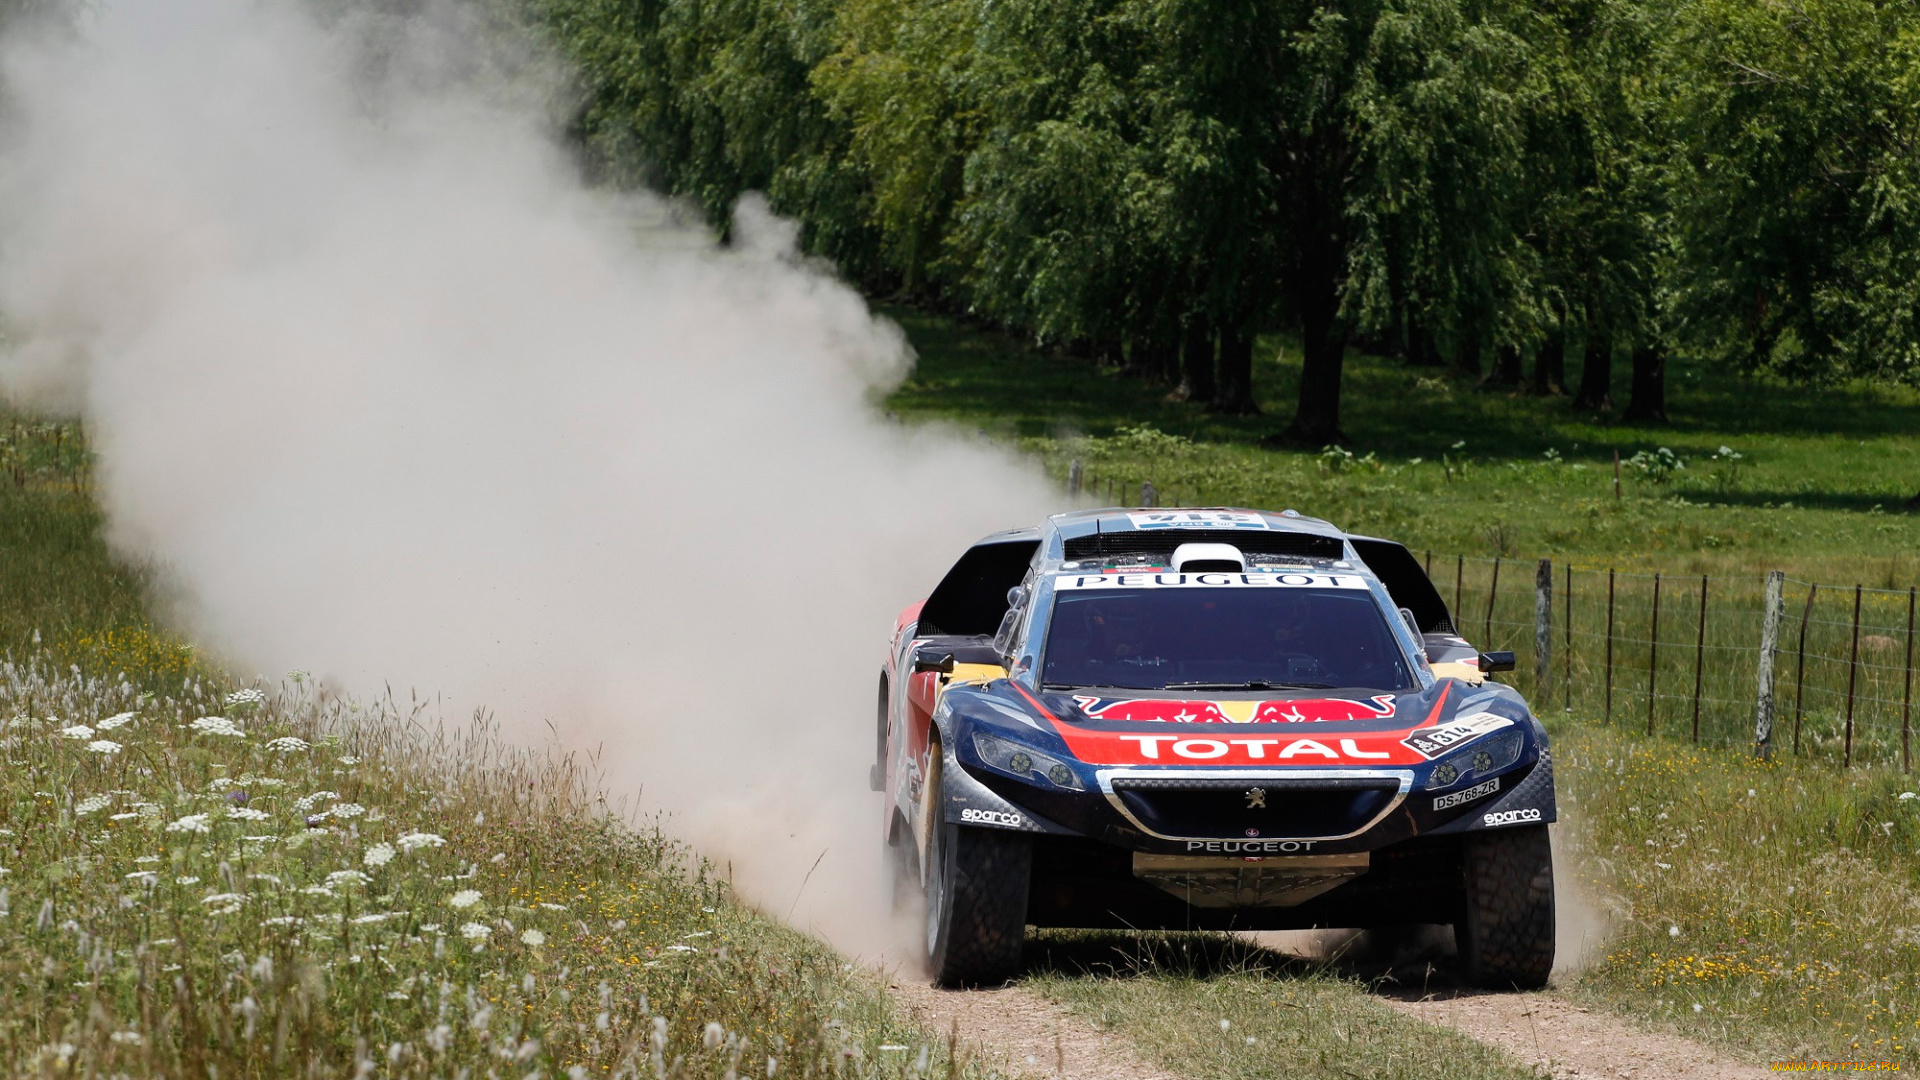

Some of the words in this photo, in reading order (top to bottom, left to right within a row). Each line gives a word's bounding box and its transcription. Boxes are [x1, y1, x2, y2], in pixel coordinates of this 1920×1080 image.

[1076, 573, 1347, 588] PEUGEOT
[1434, 727, 1472, 743] 314
[1120, 735, 1389, 759] TOTAL
[1437, 781, 1496, 809] DS-768-ZR
[962, 808, 1020, 825] sparco
[1484, 808, 1541, 826] sparco
[1187, 841, 1317, 853] PEUGEOT
